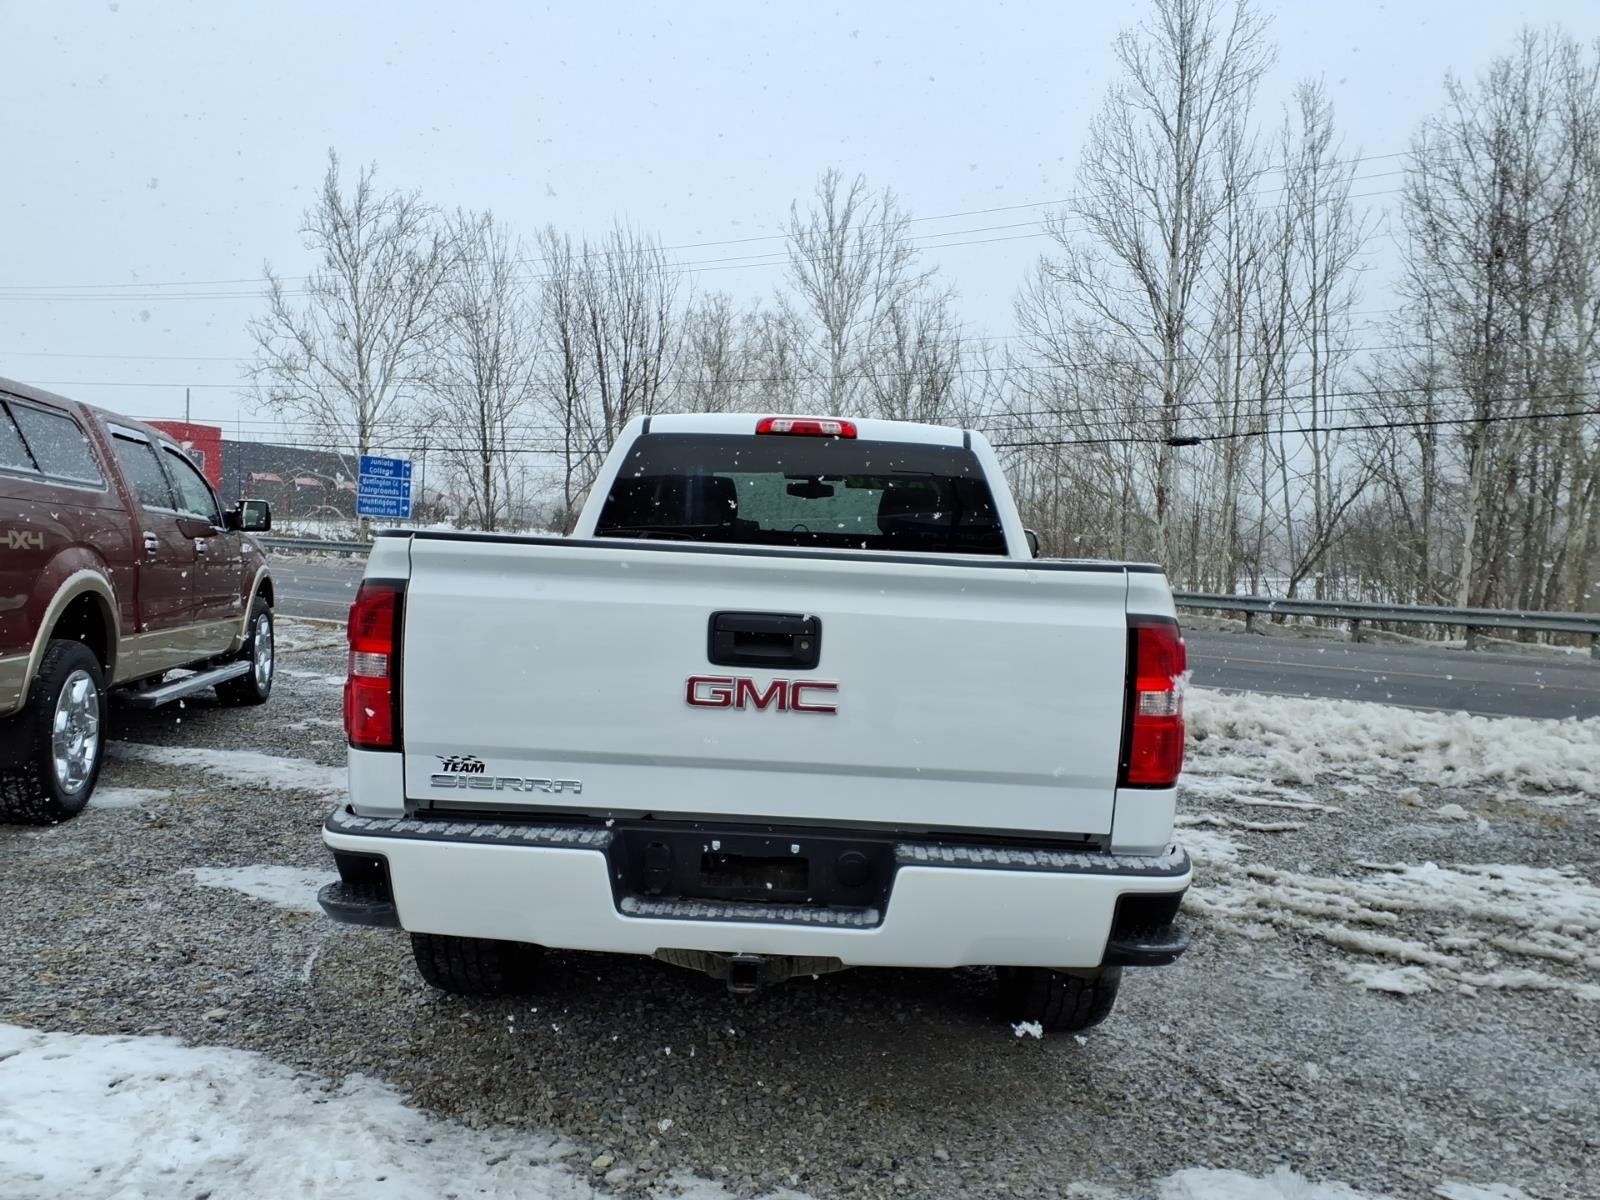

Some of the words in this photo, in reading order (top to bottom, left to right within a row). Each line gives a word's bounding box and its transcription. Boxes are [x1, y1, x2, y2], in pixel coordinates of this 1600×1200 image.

[369, 466, 394, 477] College
[360, 486, 399, 496] Fairgrounds
[685, 674, 839, 713] GMC
[442, 761, 486, 774] TEAM
[430, 773, 582, 794] SIERRA
